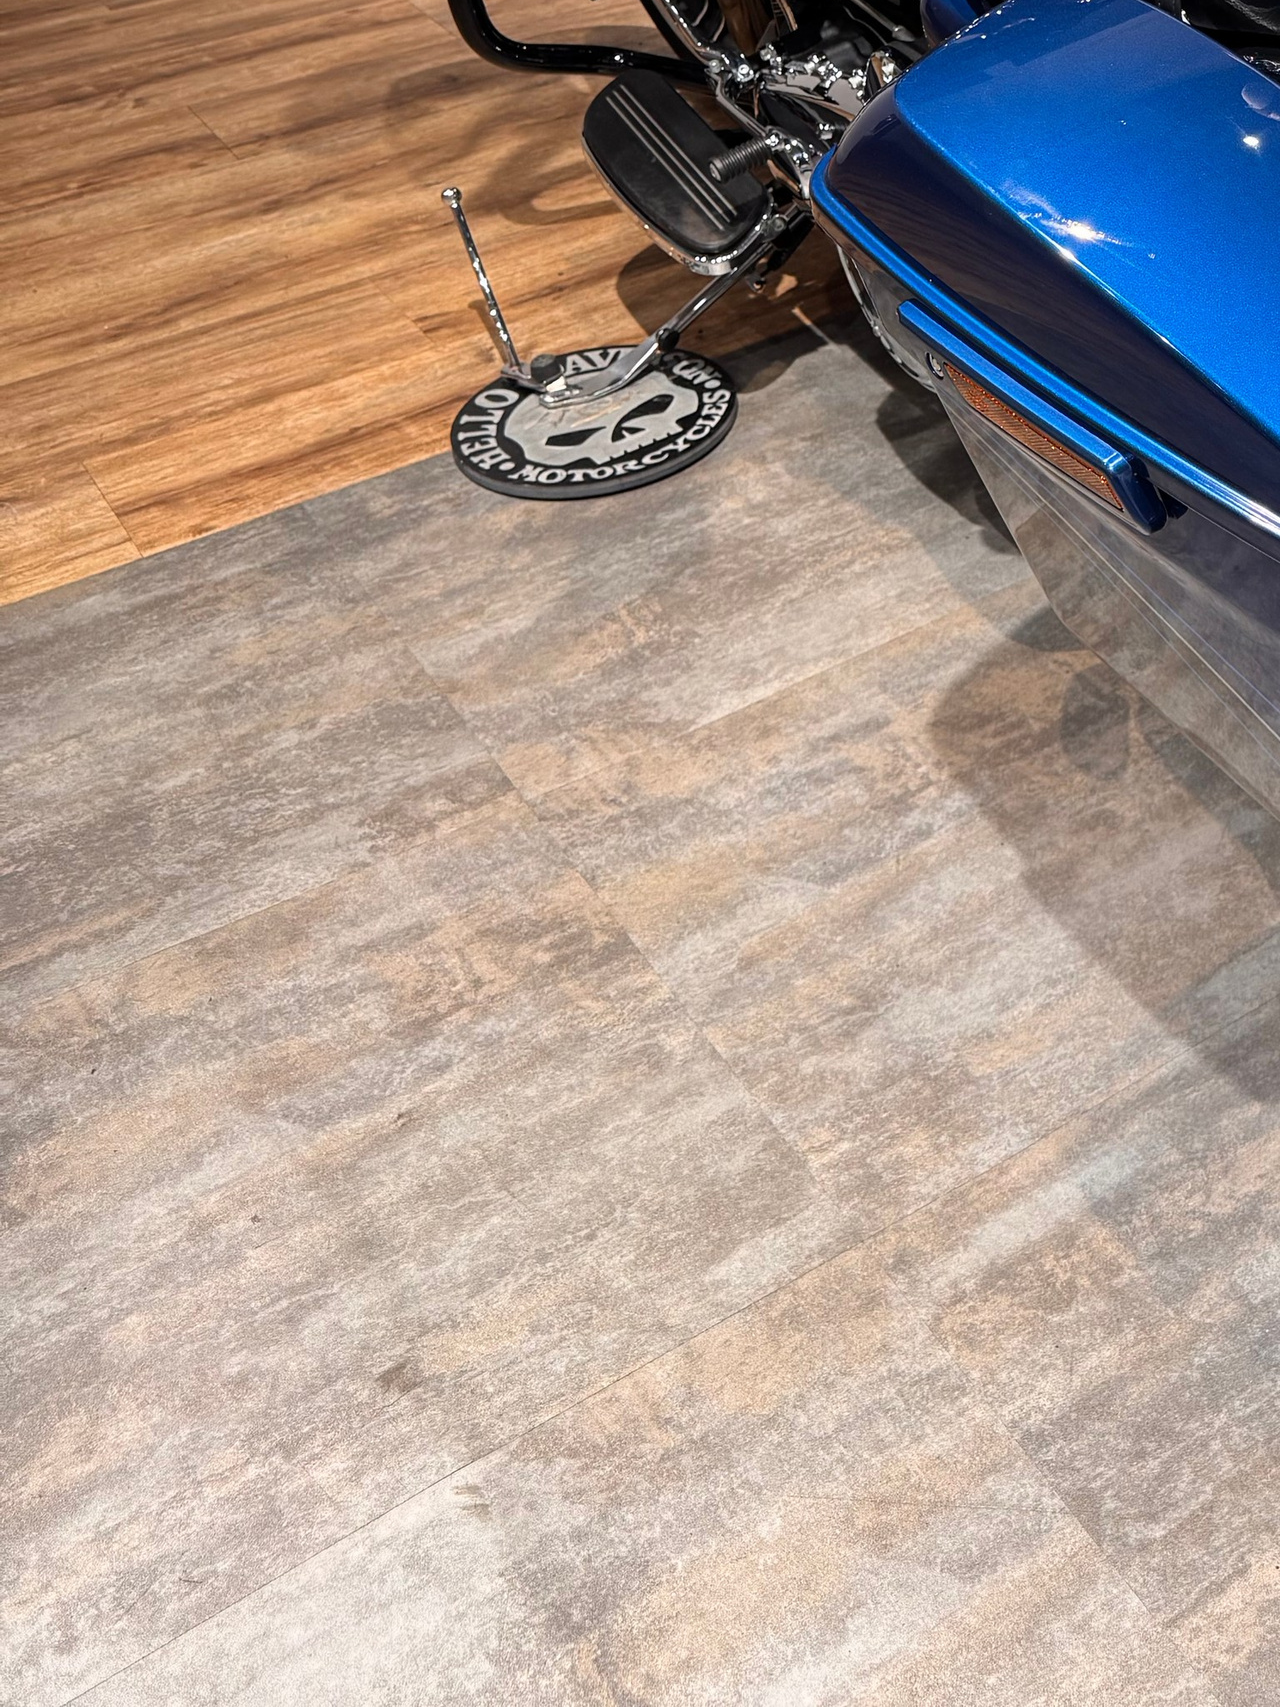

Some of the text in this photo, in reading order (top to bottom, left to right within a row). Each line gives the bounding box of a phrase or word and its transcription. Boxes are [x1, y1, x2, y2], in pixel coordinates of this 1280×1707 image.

[457, 346, 721, 470] HELLO AVSON
[507, 388, 731, 484] MOTORCYCLES
